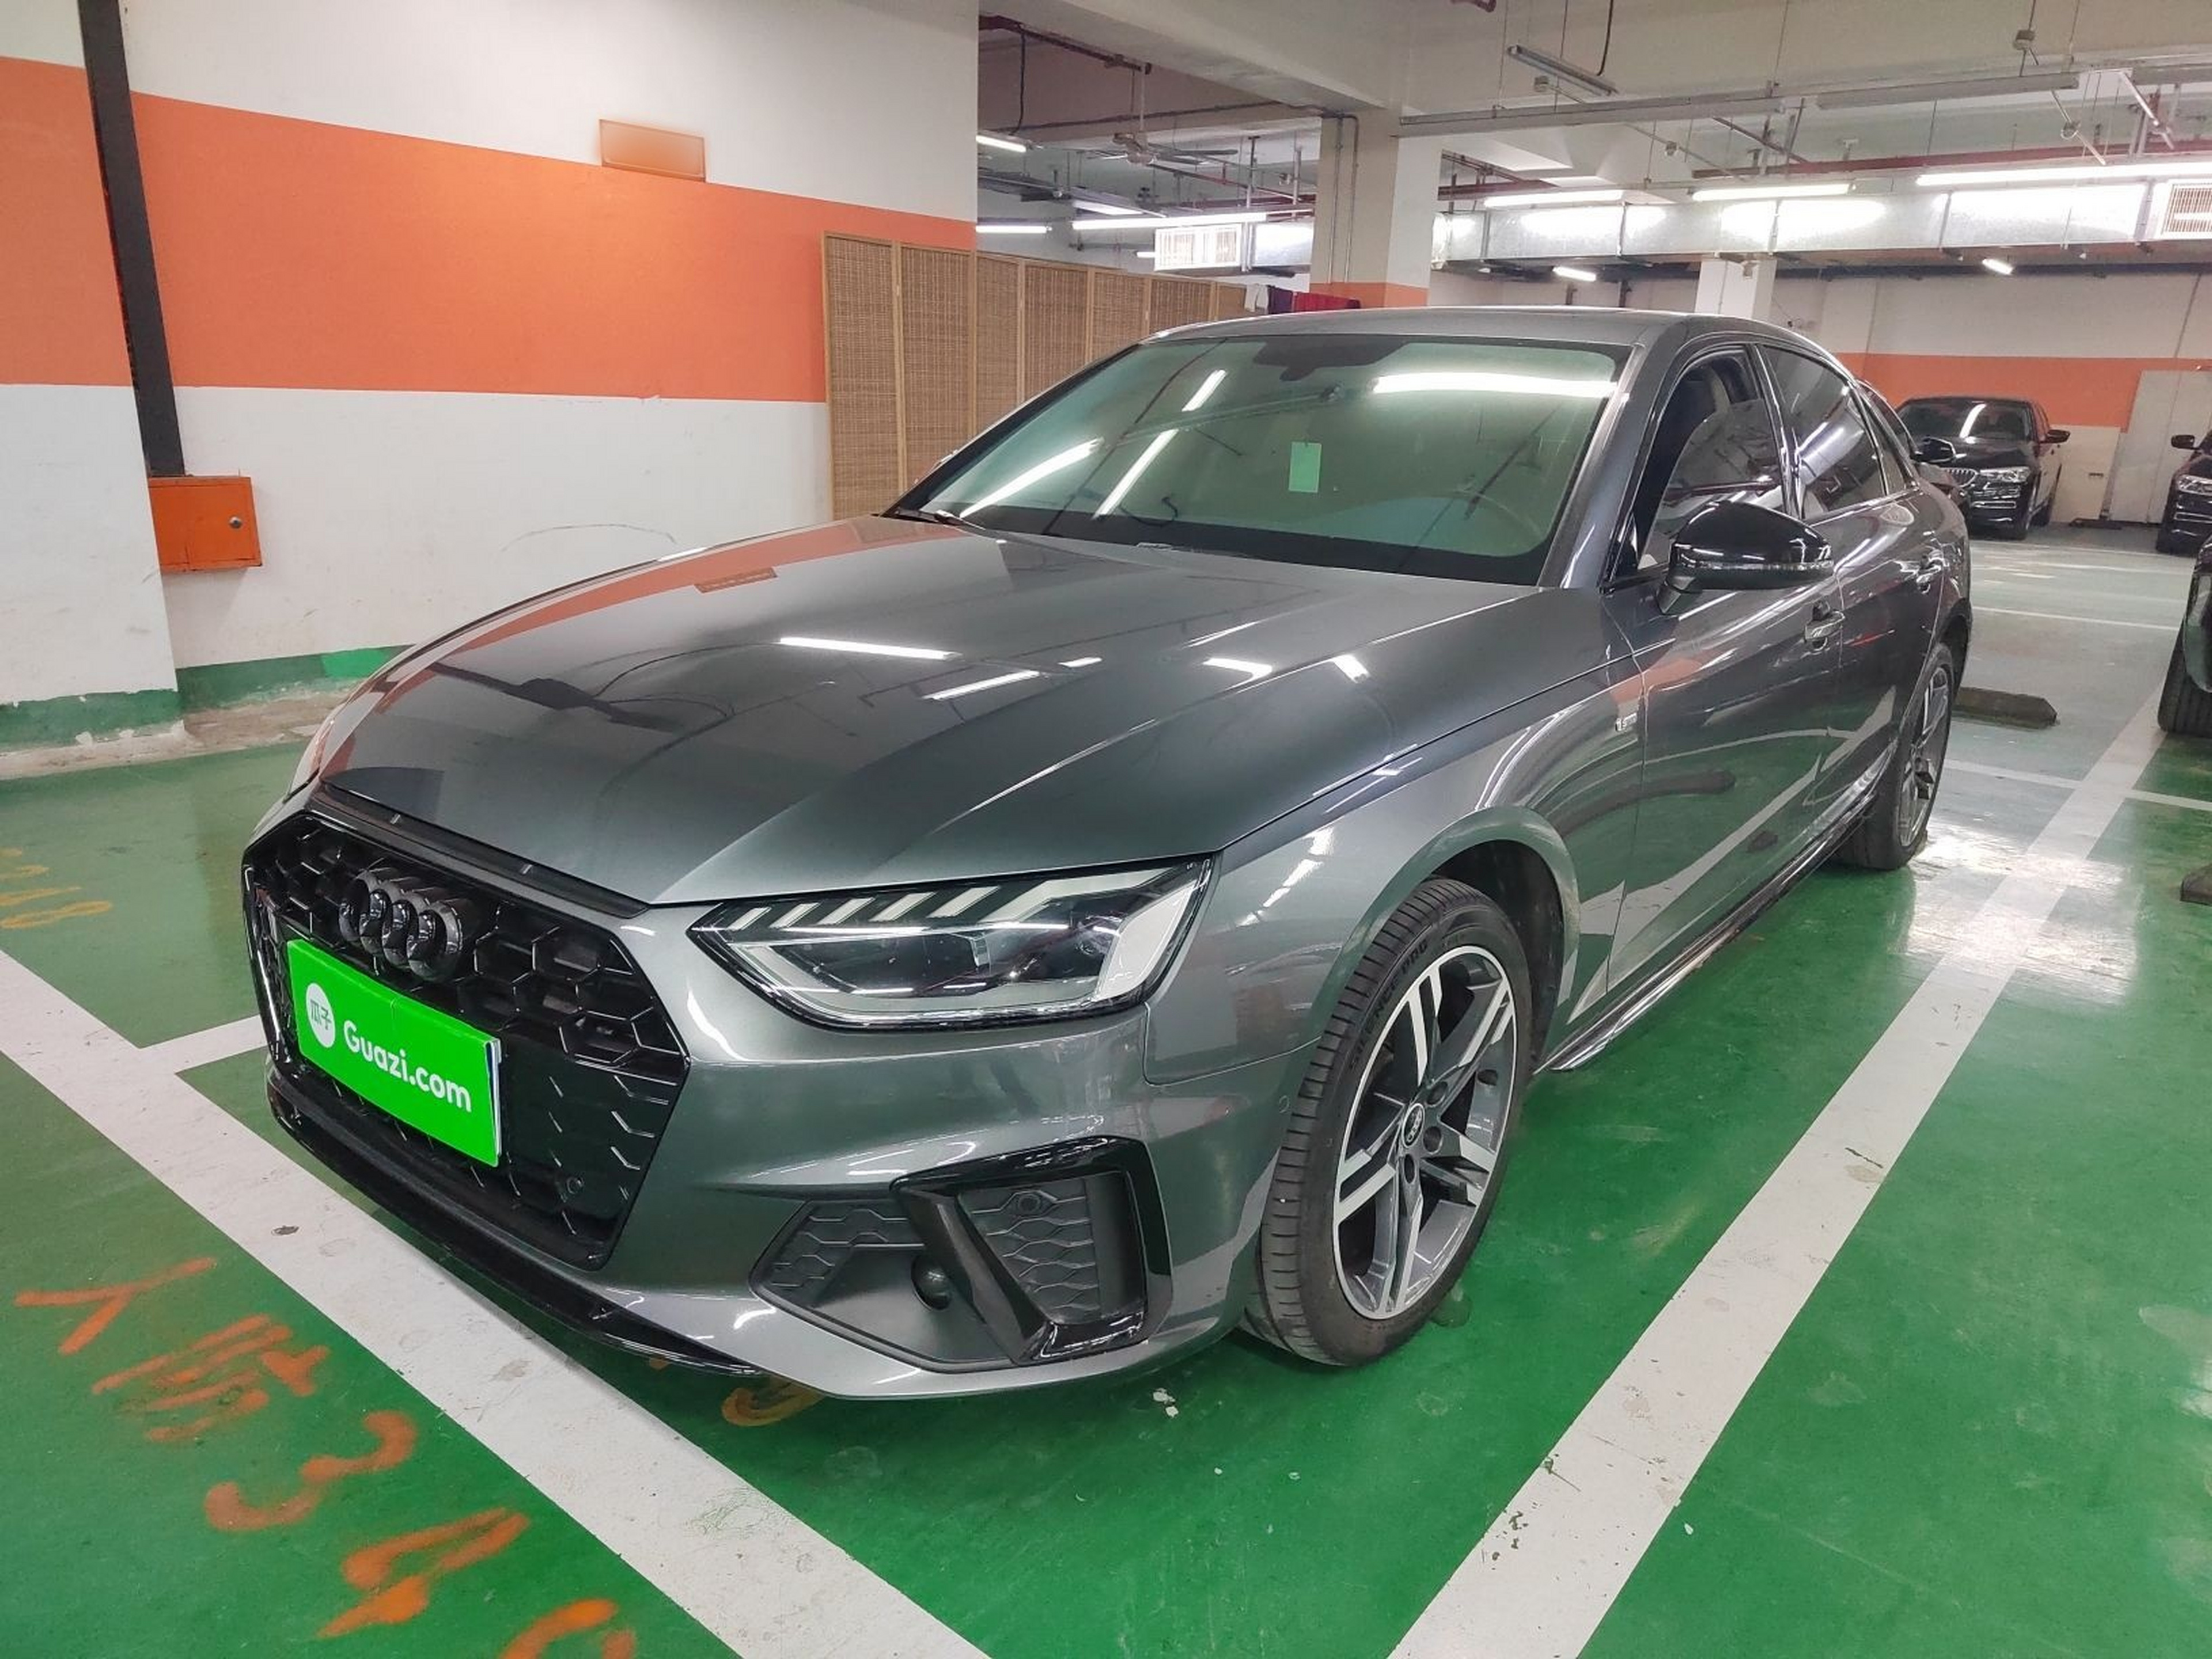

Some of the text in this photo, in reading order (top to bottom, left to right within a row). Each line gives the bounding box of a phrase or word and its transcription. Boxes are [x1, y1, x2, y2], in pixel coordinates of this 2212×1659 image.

[1400, 939, 1429, 974] PRO
[309, 998, 332, 1031] 瓜子
[343, 1020, 472, 1113] Guazi.com
